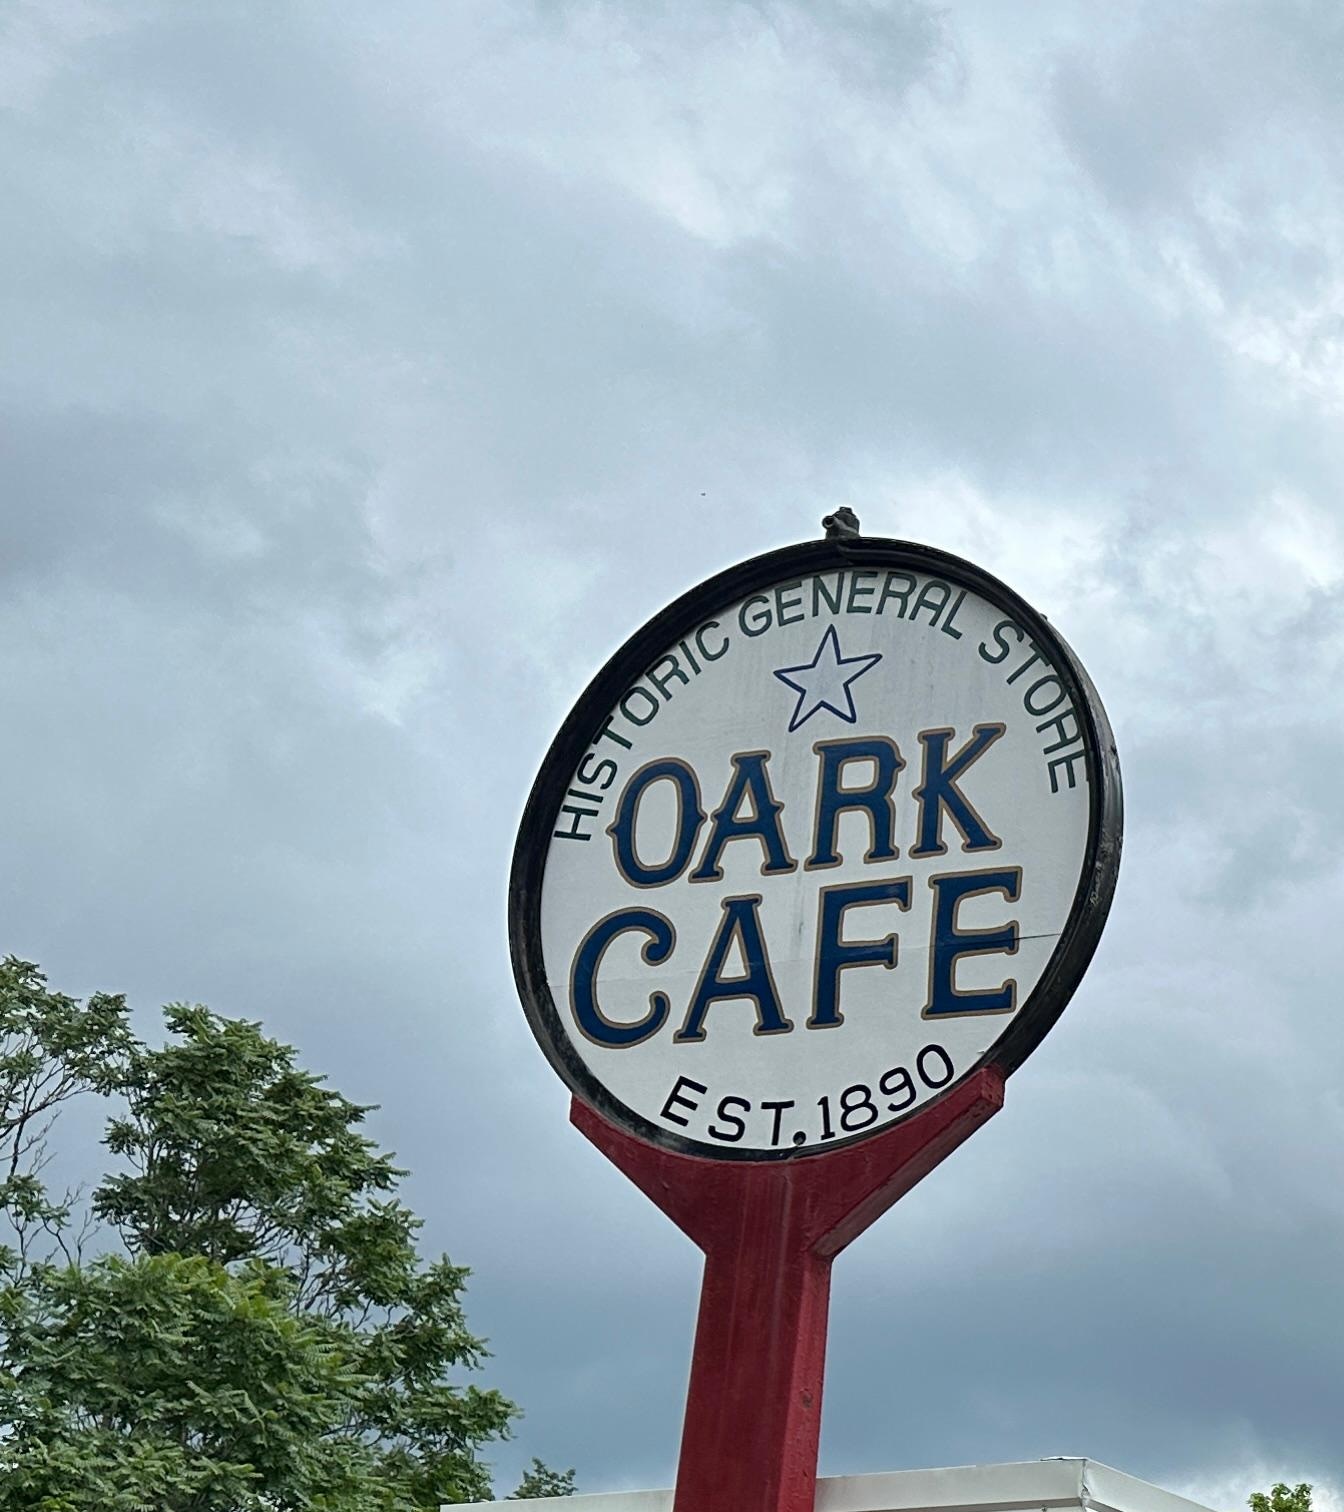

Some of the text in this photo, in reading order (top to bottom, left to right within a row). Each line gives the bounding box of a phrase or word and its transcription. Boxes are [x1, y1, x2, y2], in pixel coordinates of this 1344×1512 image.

[553, 570, 1091, 843] HISTORIC GENERAL STORE
[606, 722, 1007, 889] OARK
[568, 866, 1023, 1050] CAFE
